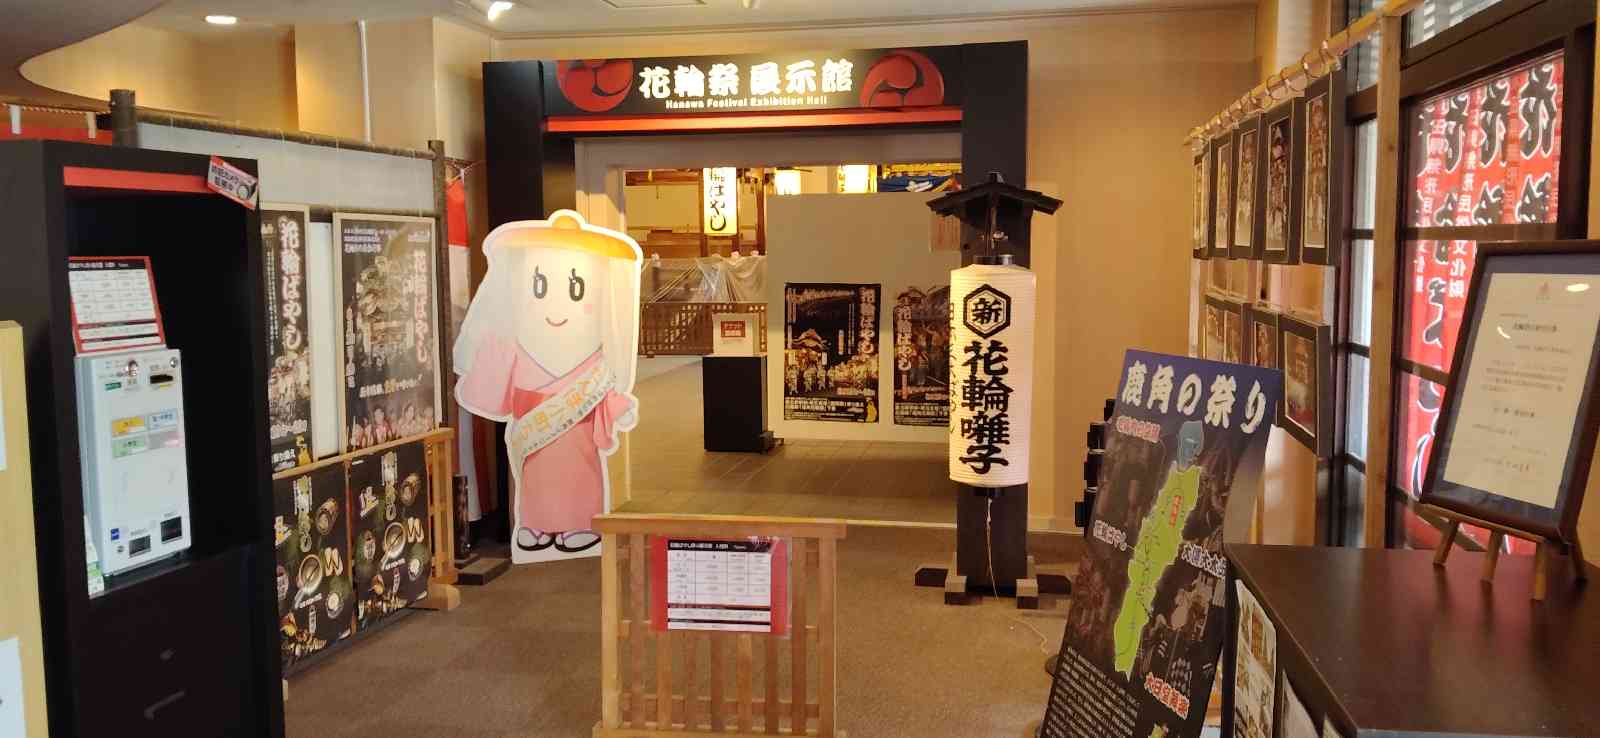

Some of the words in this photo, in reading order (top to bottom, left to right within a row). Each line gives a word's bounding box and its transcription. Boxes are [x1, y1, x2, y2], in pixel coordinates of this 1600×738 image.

[639, 62, 740, 99] 花輪祭
[750, 58, 854, 96] 展示館
[666, 99, 705, 109] Hanawa
[707, 98, 747, 108] Festival
[750, 96, 803, 107] Exhibition
[807, 95, 828, 105] Hall
[278, 215, 302, 351] 花輪ばやし
[858, 287, 876, 354] 花輪ばやし
[958, 338, 1014, 475] 花輪囃子
[1121, 359, 1268, 435] 鹿角の祭り
